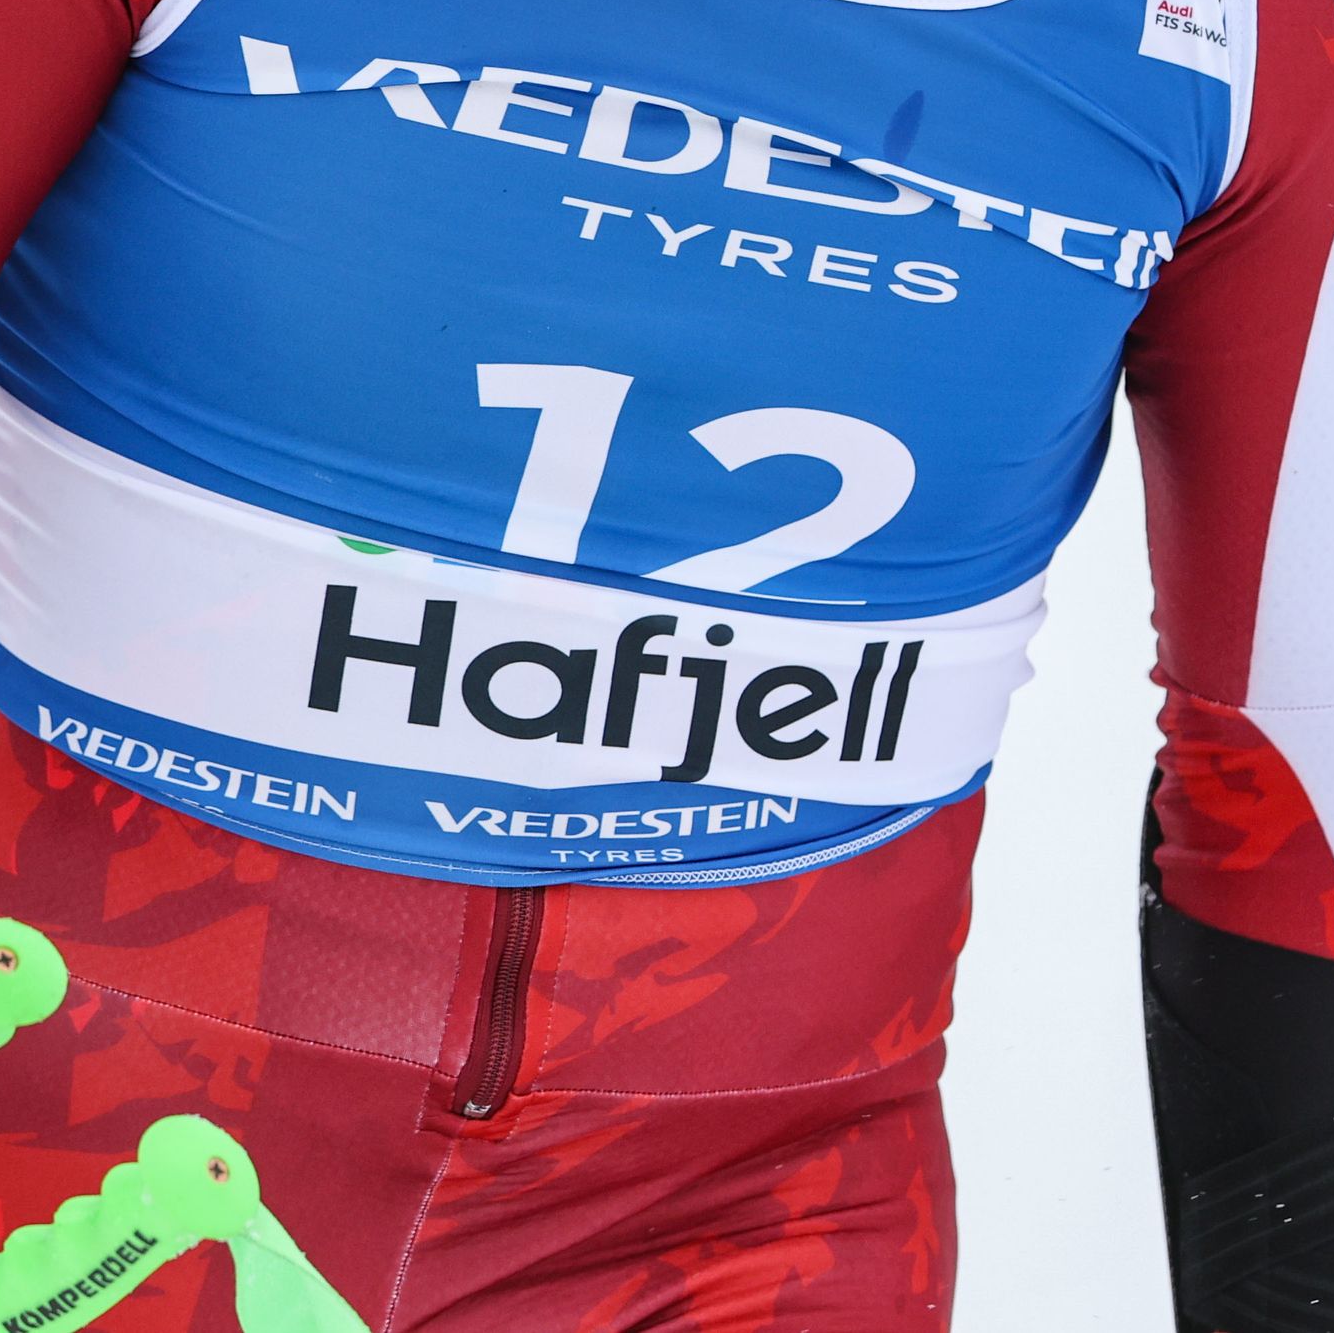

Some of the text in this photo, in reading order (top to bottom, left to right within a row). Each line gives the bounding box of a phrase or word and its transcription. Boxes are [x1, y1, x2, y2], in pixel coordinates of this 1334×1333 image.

[1155, 13, 1179, 30] FIS
[1182, 21, 1203, 37] Ski
[1157, 0, 1193, 18] Audi
[561, 196, 960, 305] TYRES
[476, 363, 916, 604] 12
[307, 584, 925, 783] Hafjell
[38, 704, 357, 821] VREDESTEIN
[424, 796, 800, 840] VREDESTEIN
[550, 847, 685, 864] TYRES
[2, 1229, 159, 1333] KOMPERDELL
